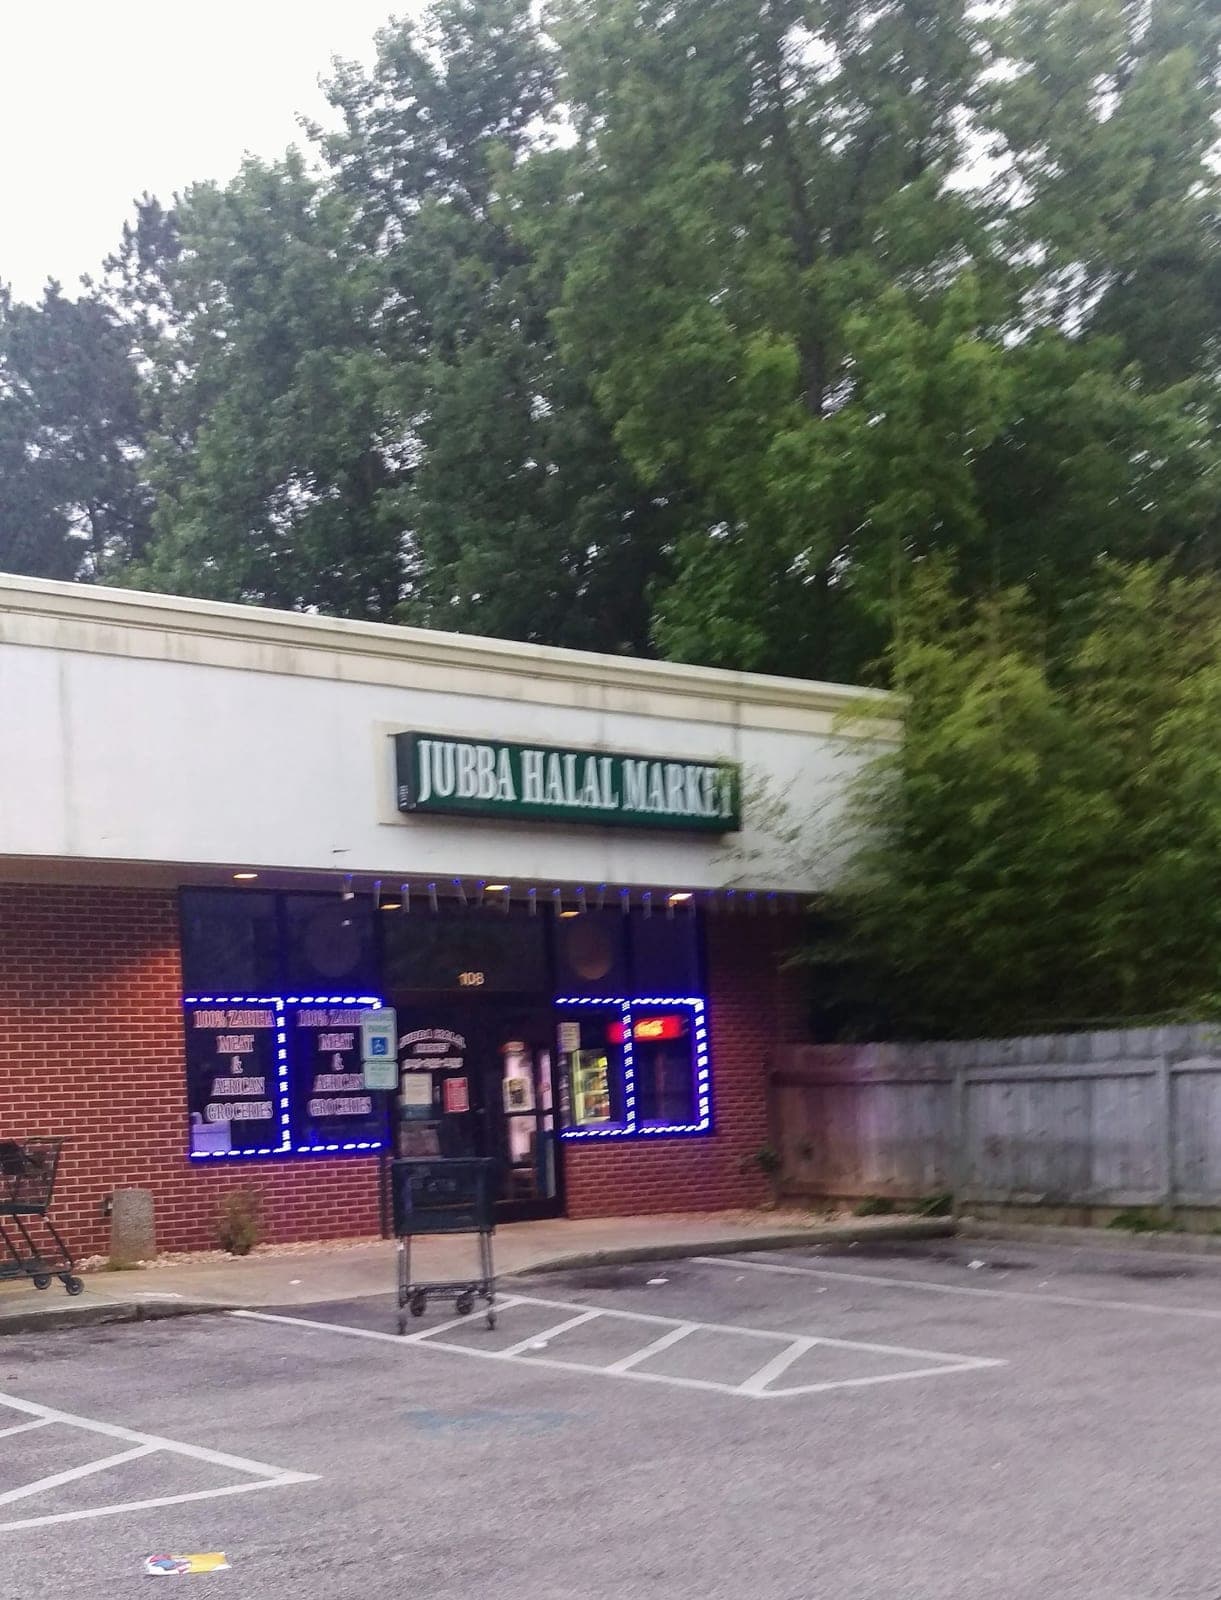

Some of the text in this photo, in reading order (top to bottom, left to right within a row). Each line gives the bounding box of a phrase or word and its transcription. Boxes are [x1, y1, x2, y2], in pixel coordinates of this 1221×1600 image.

[417, 739, 733, 818] JUBBA HALAL MARKET
[459, 971, 485, 986] 108
[193, 1010, 226, 1028] 100%
[216, 1034, 254, 1053] MEAT
[318, 1032, 355, 1050] MEAT
[231, 1055, 243, 1074] &
[332, 1052, 344, 1071] &
[211, 1076, 266, 1096] AFRICAN
[204, 1101, 273, 1120] GROCERIES
[307, 1096, 372, 1116] GROCERIES
